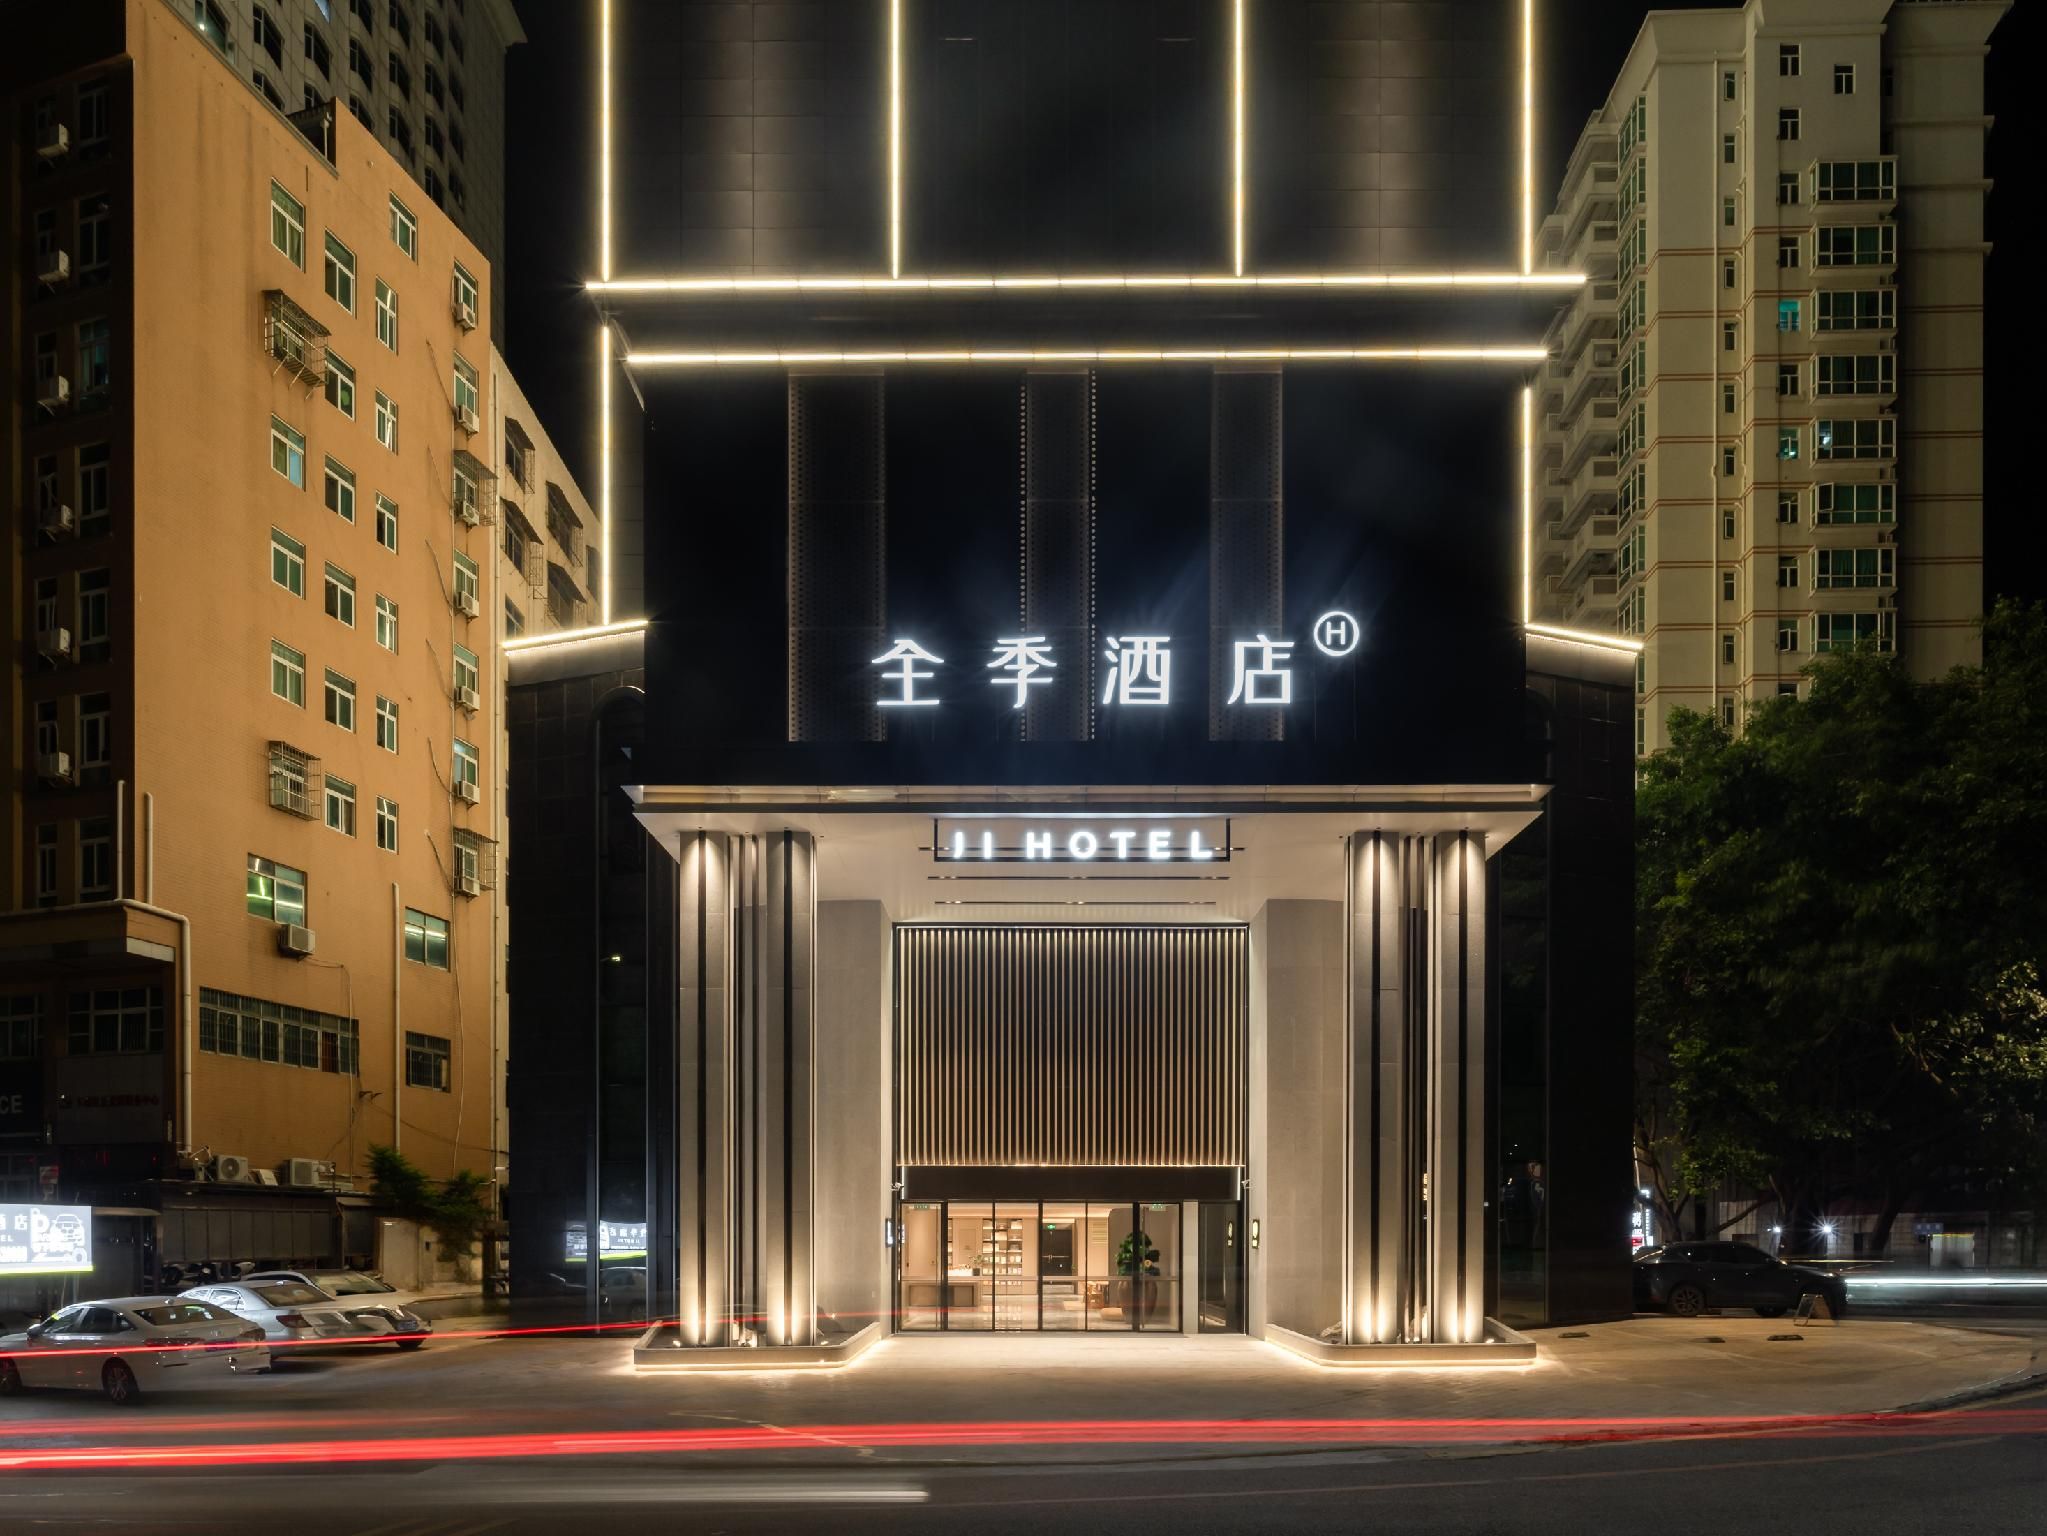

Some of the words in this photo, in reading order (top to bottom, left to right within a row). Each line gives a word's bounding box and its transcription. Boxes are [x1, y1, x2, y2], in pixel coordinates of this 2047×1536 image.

[871, 634, 1296, 709] 全季酒店
[952, 830, 993, 860] JI
[1025, 830, 1214, 860] HOTEL
